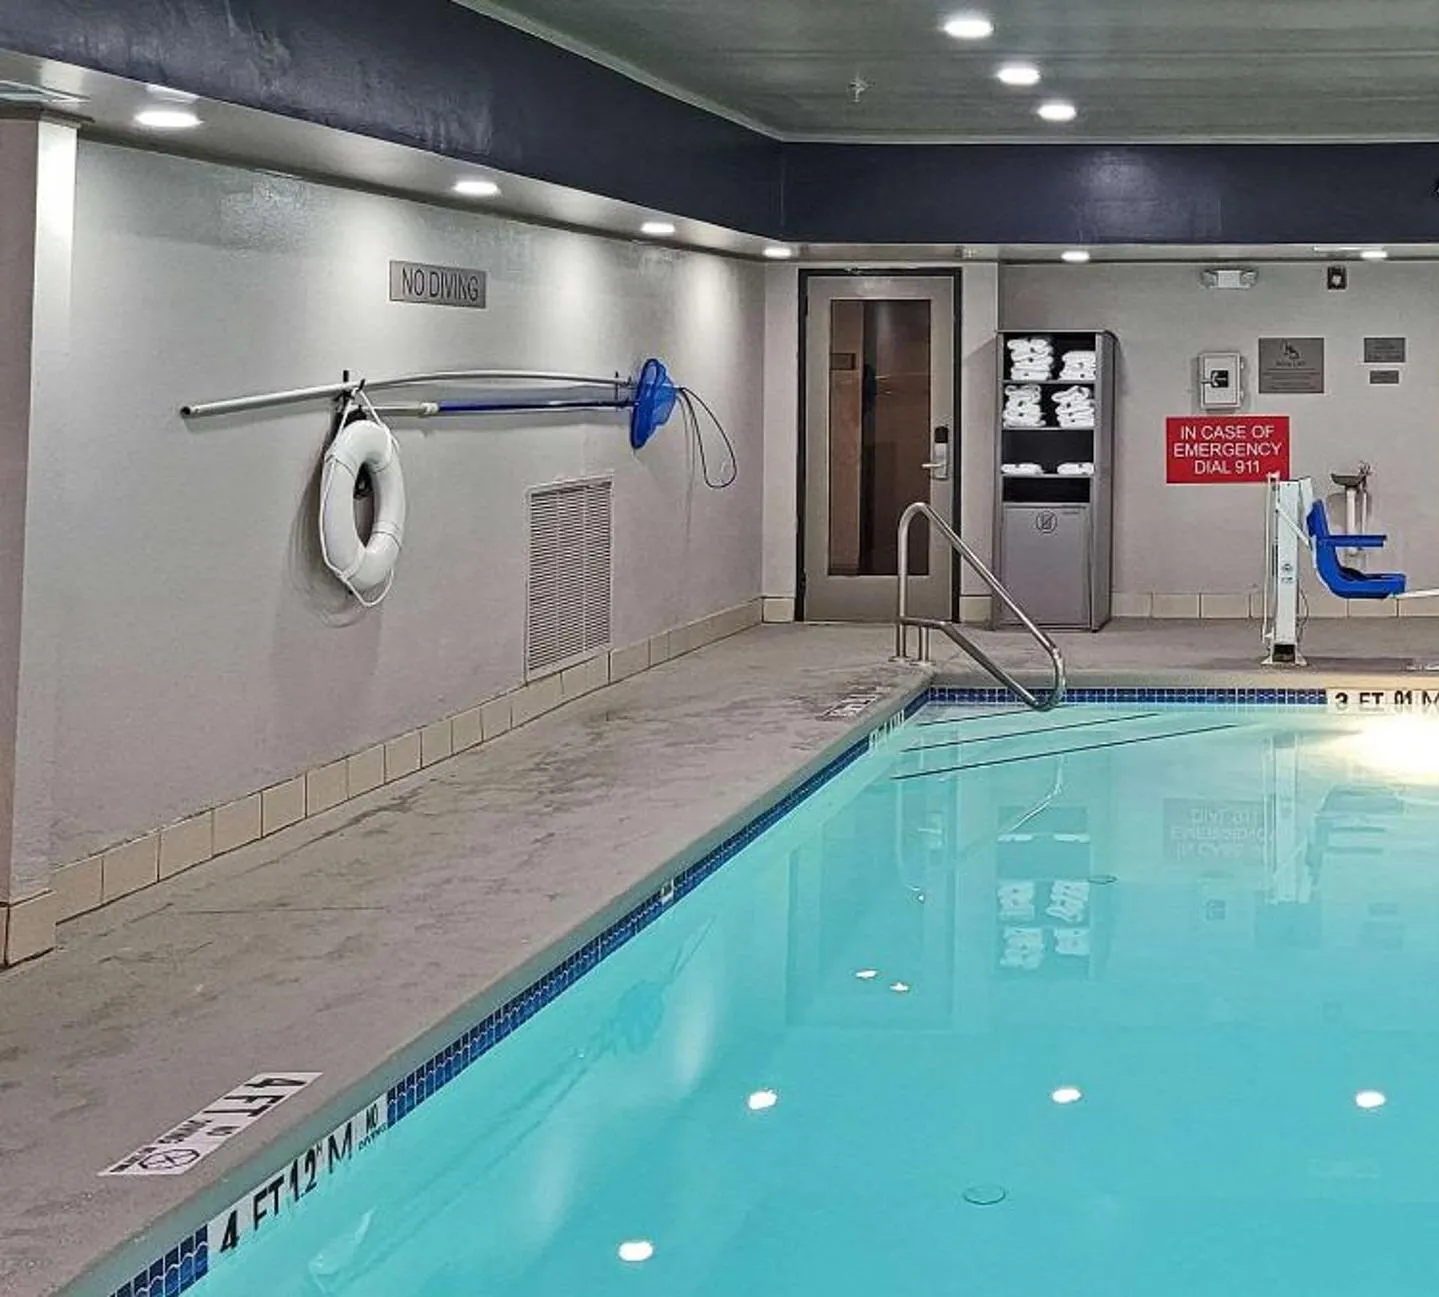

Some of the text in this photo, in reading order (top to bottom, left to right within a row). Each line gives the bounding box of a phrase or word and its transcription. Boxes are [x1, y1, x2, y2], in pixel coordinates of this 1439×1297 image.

[402, 267, 479, 302] NO DIVING
[1181, 425, 1276, 440] IN CASE OF
[1173, 441, 1283, 457] EMERGENCY
[1194, 459, 1261, 475] DIAL 911
[1359, 691, 1385, 705] FT
[203, 1078, 307, 1118] 4 FT
[221, 1210, 240, 1252] 4
[253, 1175, 285, 1231] FT
[328, 1134, 352, 1174] M
